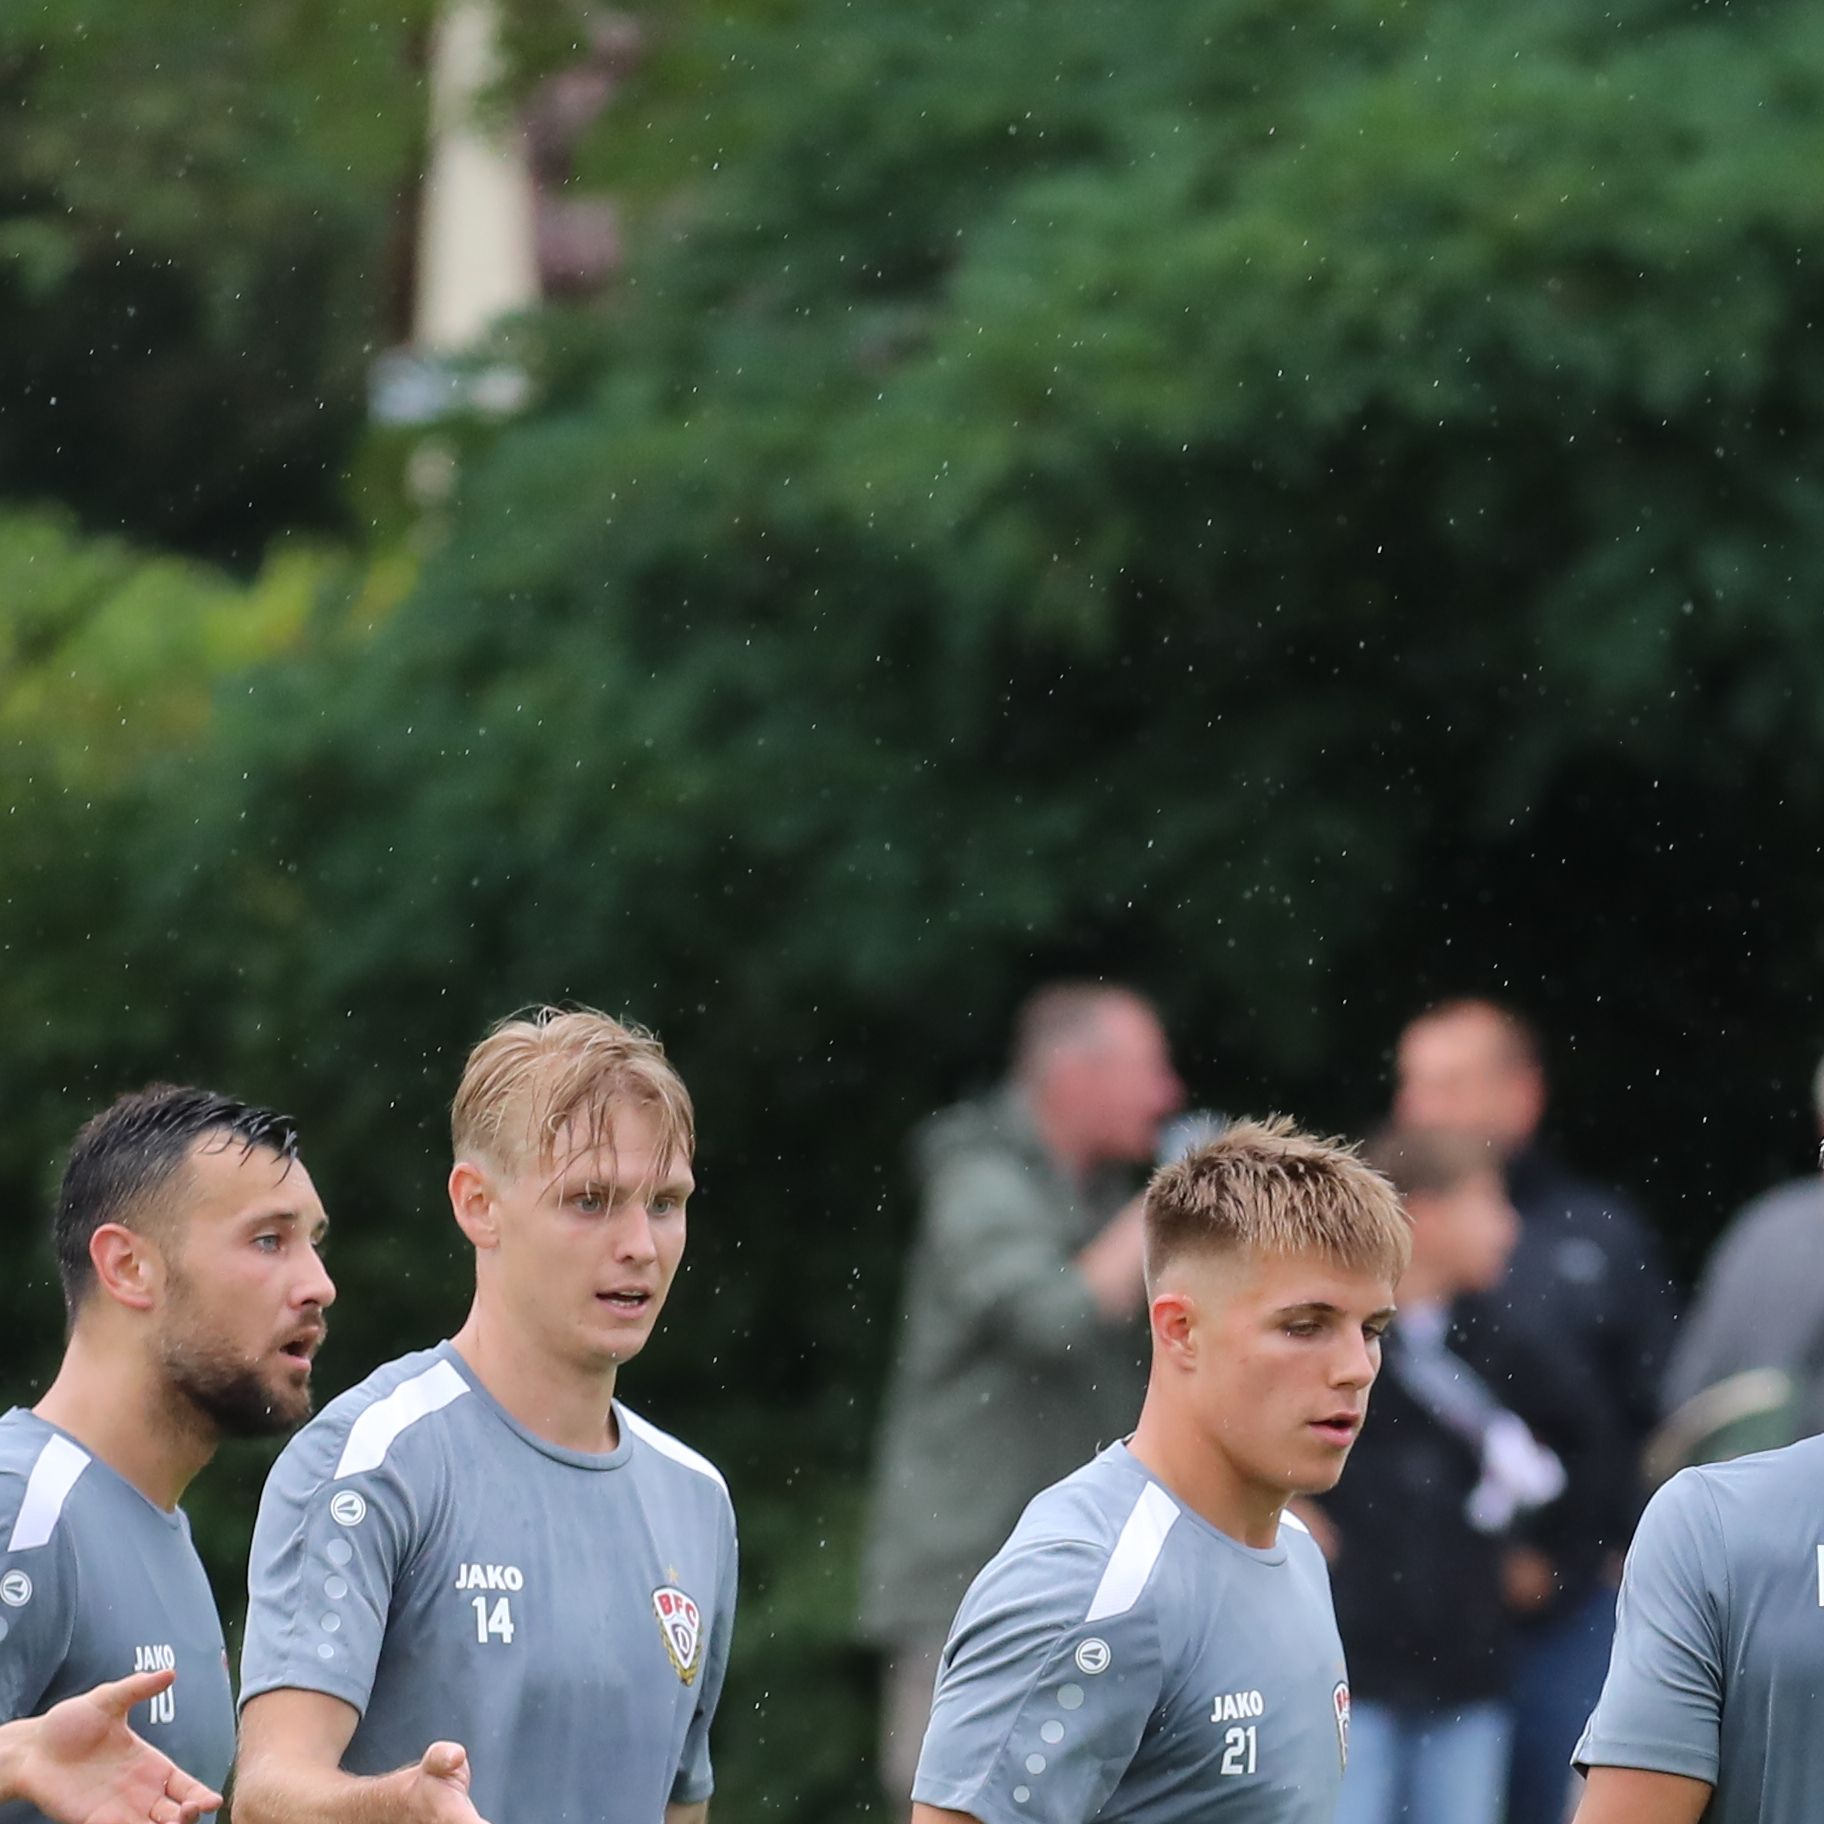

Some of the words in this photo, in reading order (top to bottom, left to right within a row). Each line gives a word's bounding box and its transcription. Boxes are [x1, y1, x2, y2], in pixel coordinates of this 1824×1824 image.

[455, 1563, 523, 1591] JAKO
[472, 1596, 514, 1643] 14
[657, 1593, 697, 1628] BFC
[134, 1645, 175, 1671] JAKO
[1210, 1690, 1264, 1722] JAKO
[1220, 1726, 1256, 1774] 21
